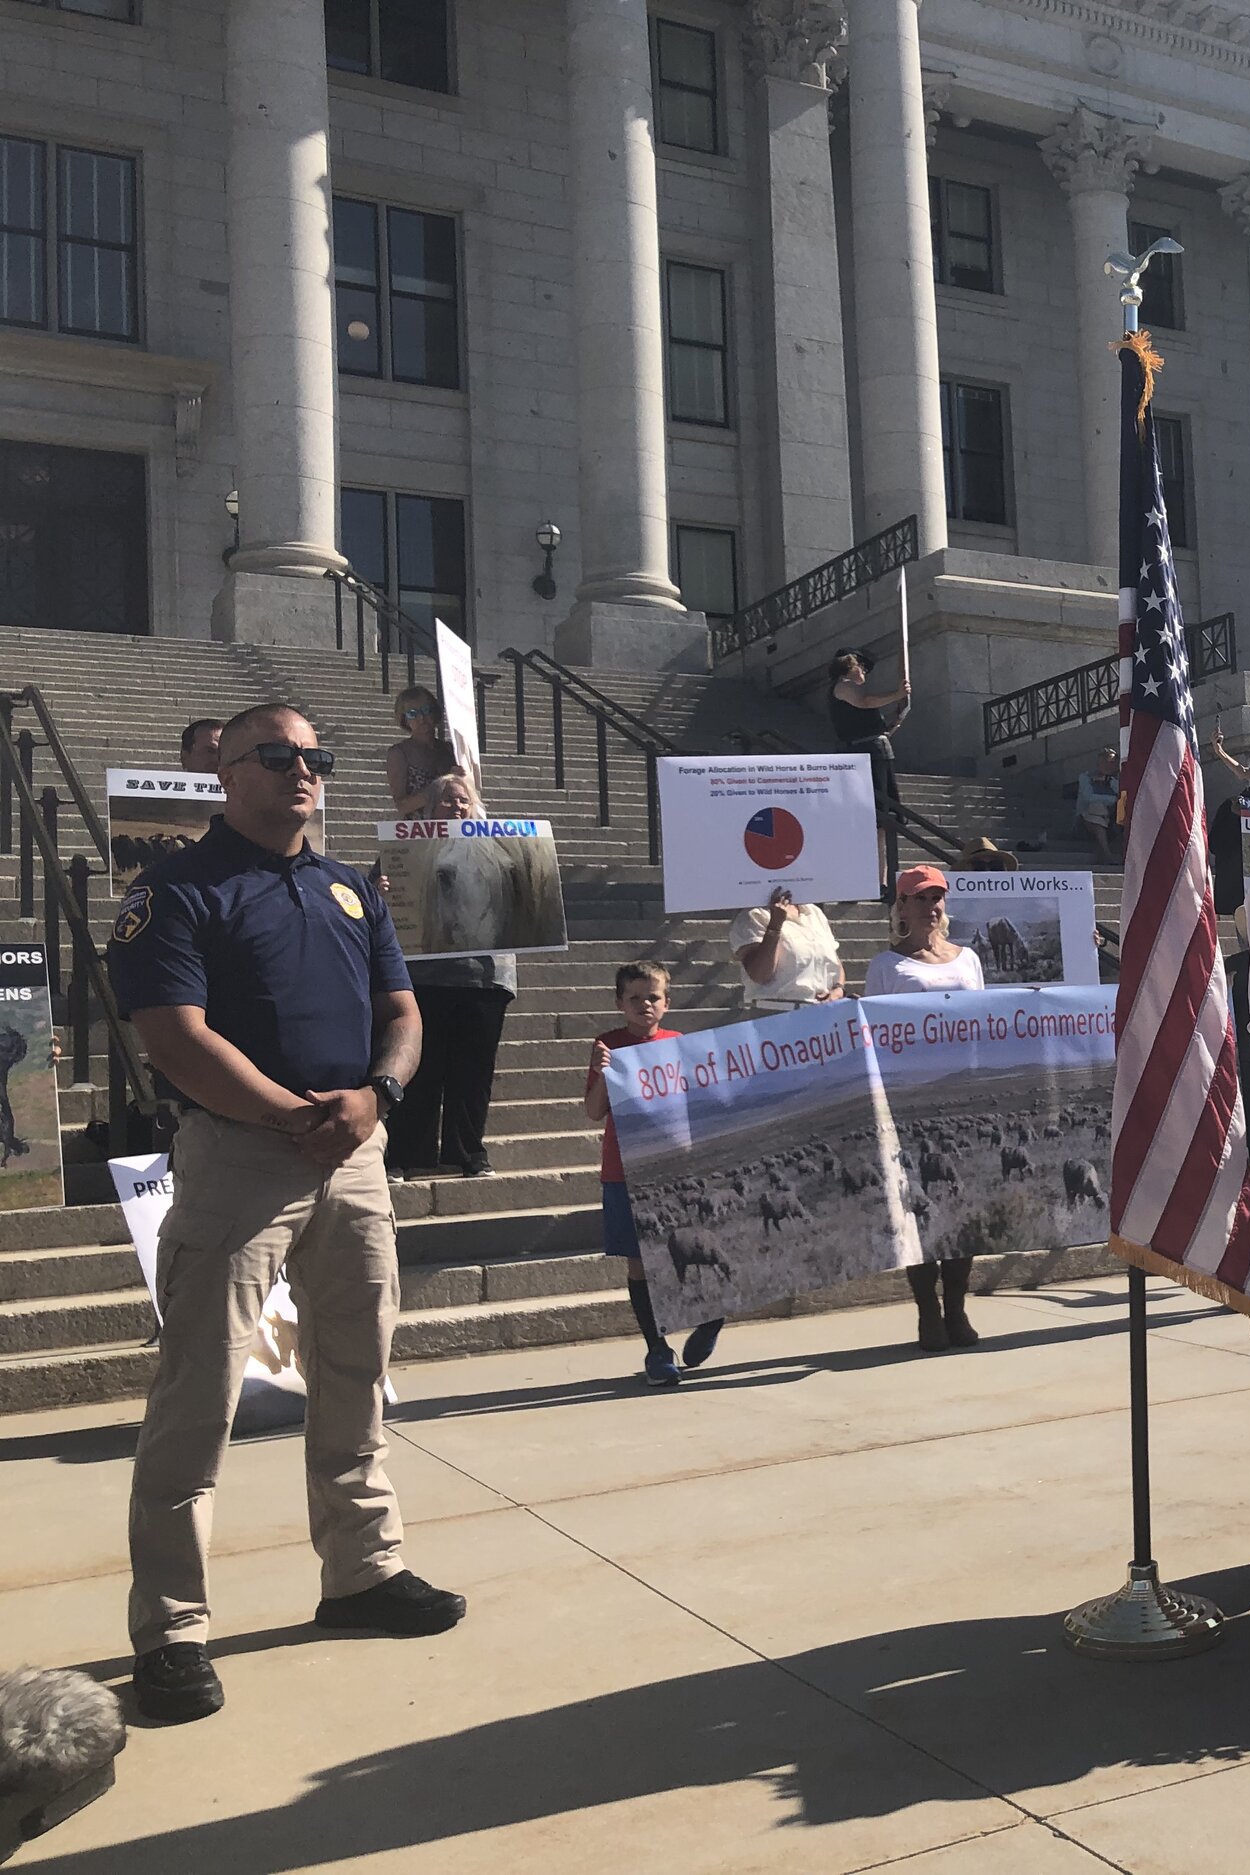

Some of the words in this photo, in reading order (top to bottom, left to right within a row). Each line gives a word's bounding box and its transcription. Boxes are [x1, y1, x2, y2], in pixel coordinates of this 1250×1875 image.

[679, 766, 706, 775] Forage
[708, 765, 746, 773] Allocation
[748, 765, 755, 773] in
[806, 763, 827, 771] Burro
[126, 779, 187, 792] SAVE
[193, 782, 226, 794] TH
[395, 822, 449, 839] SAVE
[461, 821, 537, 837] ONAQUI
[956, 876, 1014, 892] Control
[0, 951, 43, 964] ORS
[638, 1060, 689, 1101] 80%
[695, 1051, 718, 1088] of
[727, 1042, 756, 1081] All
[760, 1022, 843, 1071] Onaqui
[847, 1017, 916, 1054] Forage
[923, 1012, 981, 1045] Given
[986, 1012, 1008, 1041] to
